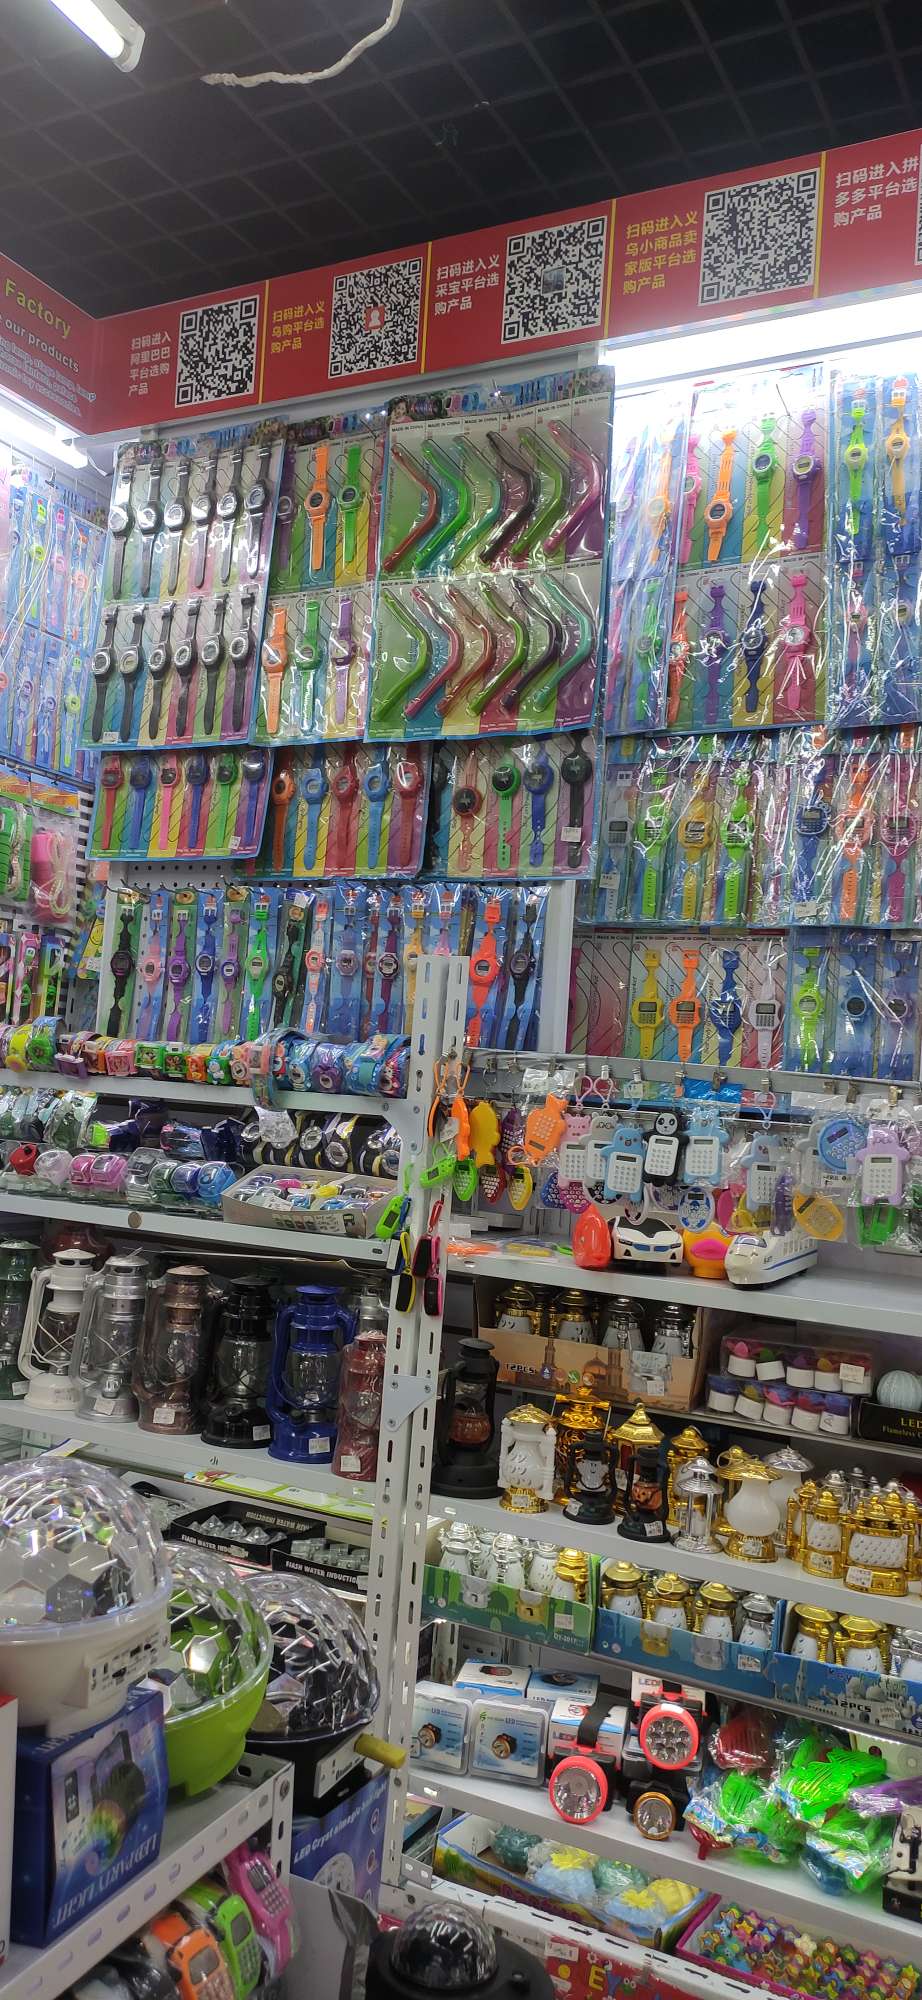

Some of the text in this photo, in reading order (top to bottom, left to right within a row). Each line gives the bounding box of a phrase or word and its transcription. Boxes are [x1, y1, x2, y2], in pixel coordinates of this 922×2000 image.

[835, 155, 919, 189] 扫码进入拼
[834, 176, 918, 208] 多多平台选
[626, 210, 698, 239] 扫码进入义
[833, 204, 882, 228] 购产品
[625, 230, 697, 257] 乌小商品卖
[436, 254, 500, 280] 扫码进入义
[624, 249, 697, 276] 家版平台选
[435, 271, 500, 297] 采宝平台选
[622, 273, 666, 295] 购产品
[4, 278, 72, 339] Factory
[272, 300, 325, 323] 扫码进入义
[434, 295, 472, 315] 购产品
[271, 317, 325, 338] 乌购平台选
[5, 319, 26, 336] our
[28, 333, 80, 373] products
[131, 331, 172, 350] 扫码进入
[270, 336, 302, 354] 购产品
[130, 346, 171, 366] 阿里巴巴
[129, 362, 170, 380] 平台选购
[128, 382, 149, 397] 产品
[304, 1565, 325, 1577] WATER
[326, 1571, 359, 1584] INDUCTIO
[834, 1699, 872, 1713] 12PCS
[293, 1844, 312, 1865] LED
